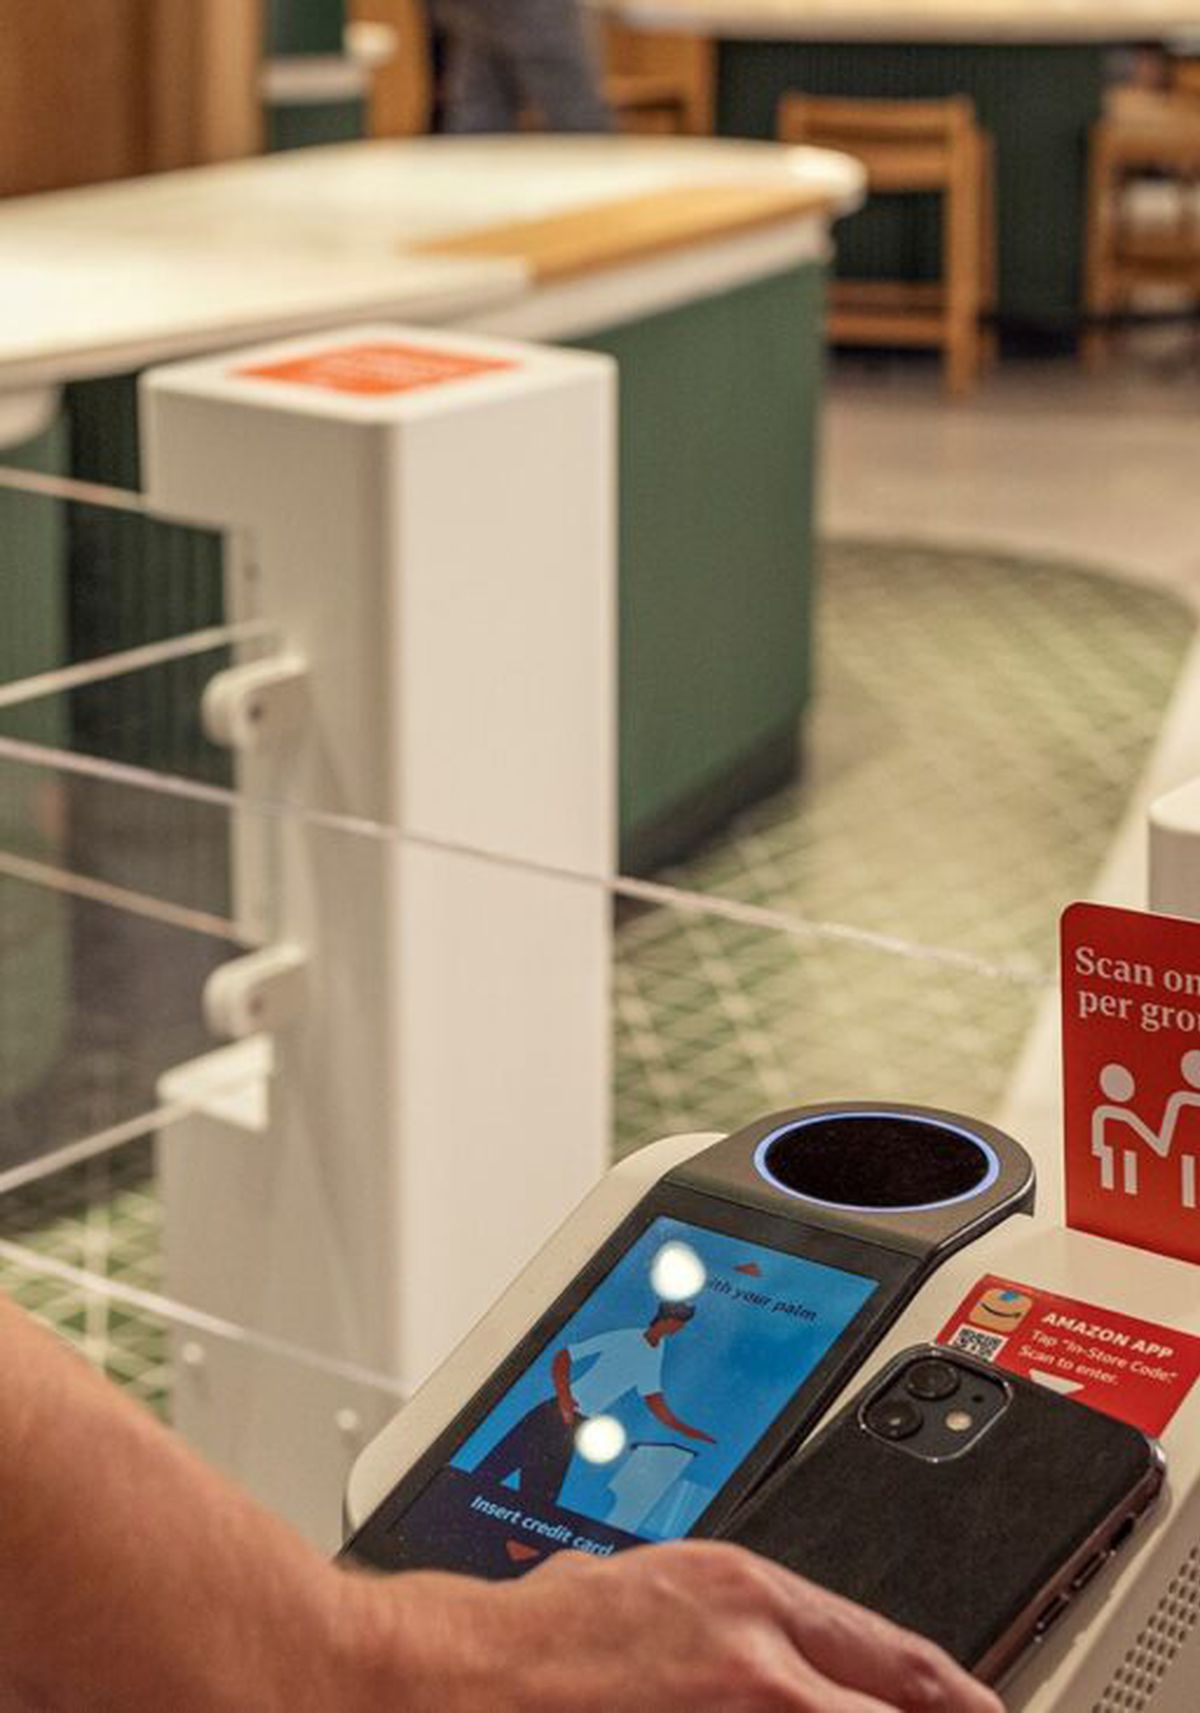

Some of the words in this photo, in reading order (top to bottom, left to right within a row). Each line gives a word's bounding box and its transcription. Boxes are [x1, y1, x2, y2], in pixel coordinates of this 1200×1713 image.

[1075, 946, 1154, 987] Scan
[1077, 989, 1133, 1019] per
[731, 1288, 772, 1306] your
[771, 1300, 818, 1321] palm
[1031, 1329, 1058, 1347] Tap
[1041, 1312, 1131, 1347] AMAZON
[1130, 1338, 1174, 1358] APP
[1018, 1344, 1055, 1365] Scan
[1057, 1357, 1074, 1370] to
[1075, 1365, 1119, 1386] enter.
[470, 1495, 523, 1526] Insert
[521, 1514, 573, 1543] credit
[572, 1536, 615, 1557] card
